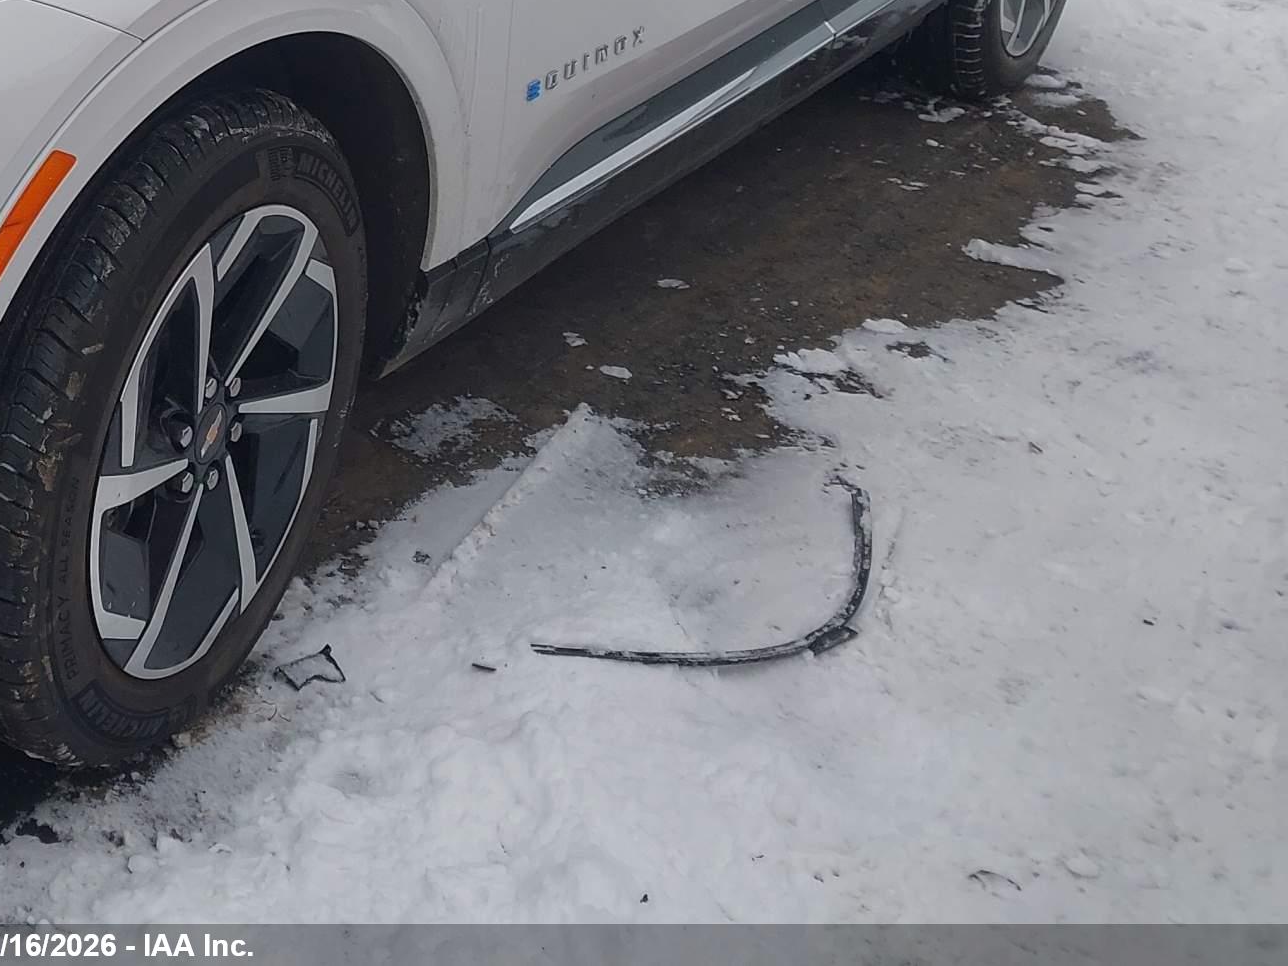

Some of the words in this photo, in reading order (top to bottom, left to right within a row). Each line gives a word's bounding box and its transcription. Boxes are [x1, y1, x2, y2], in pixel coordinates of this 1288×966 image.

[295, 152, 358, 231] MICHELIN
[61, 477, 81, 547] SEASON
[58, 555, 70, 585] ALL
[58, 595, 80, 681] PRIMACY
[78, 689, 165, 737] MICHELIN
